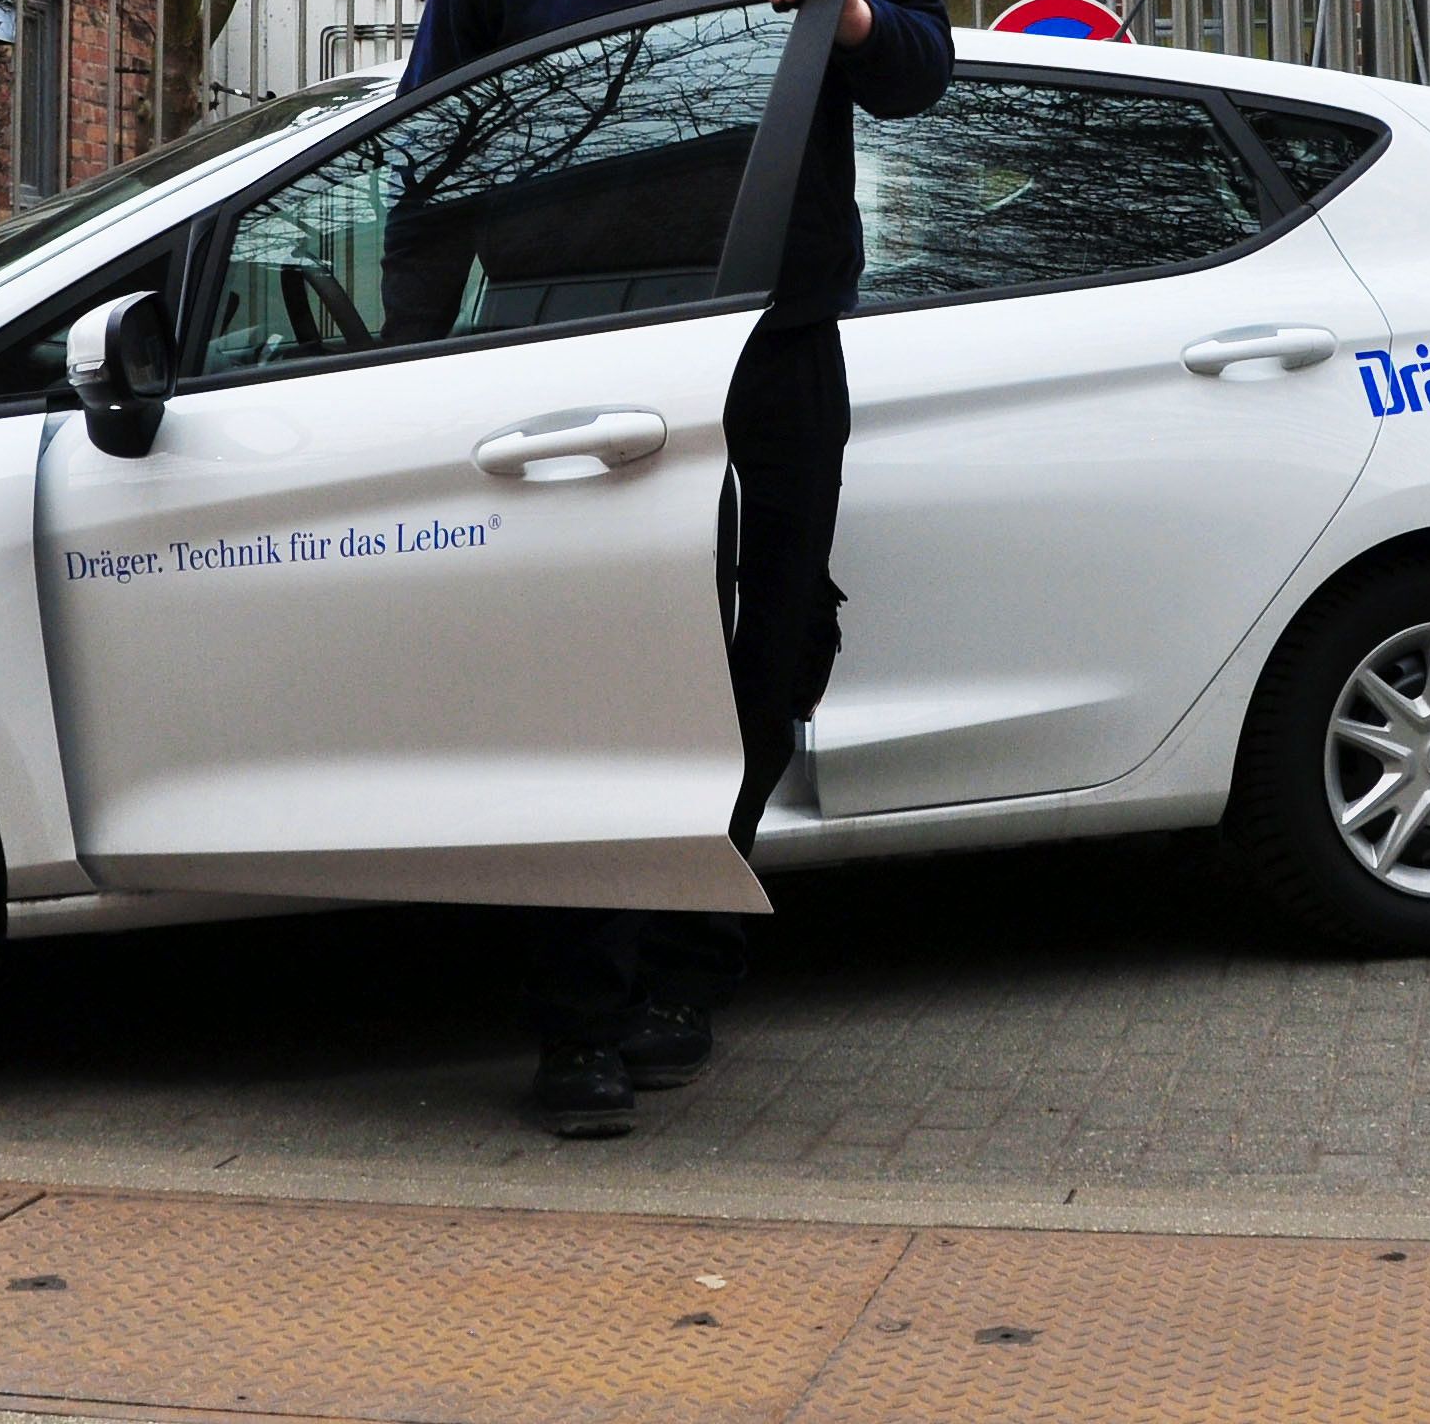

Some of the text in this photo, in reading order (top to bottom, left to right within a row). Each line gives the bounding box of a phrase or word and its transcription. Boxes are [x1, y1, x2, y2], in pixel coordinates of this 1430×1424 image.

[64, 549, 164, 585] Dräger.
[169, 535, 282, 573] Technik
[289, 531, 332, 564] für
[339, 527, 386, 559] das
